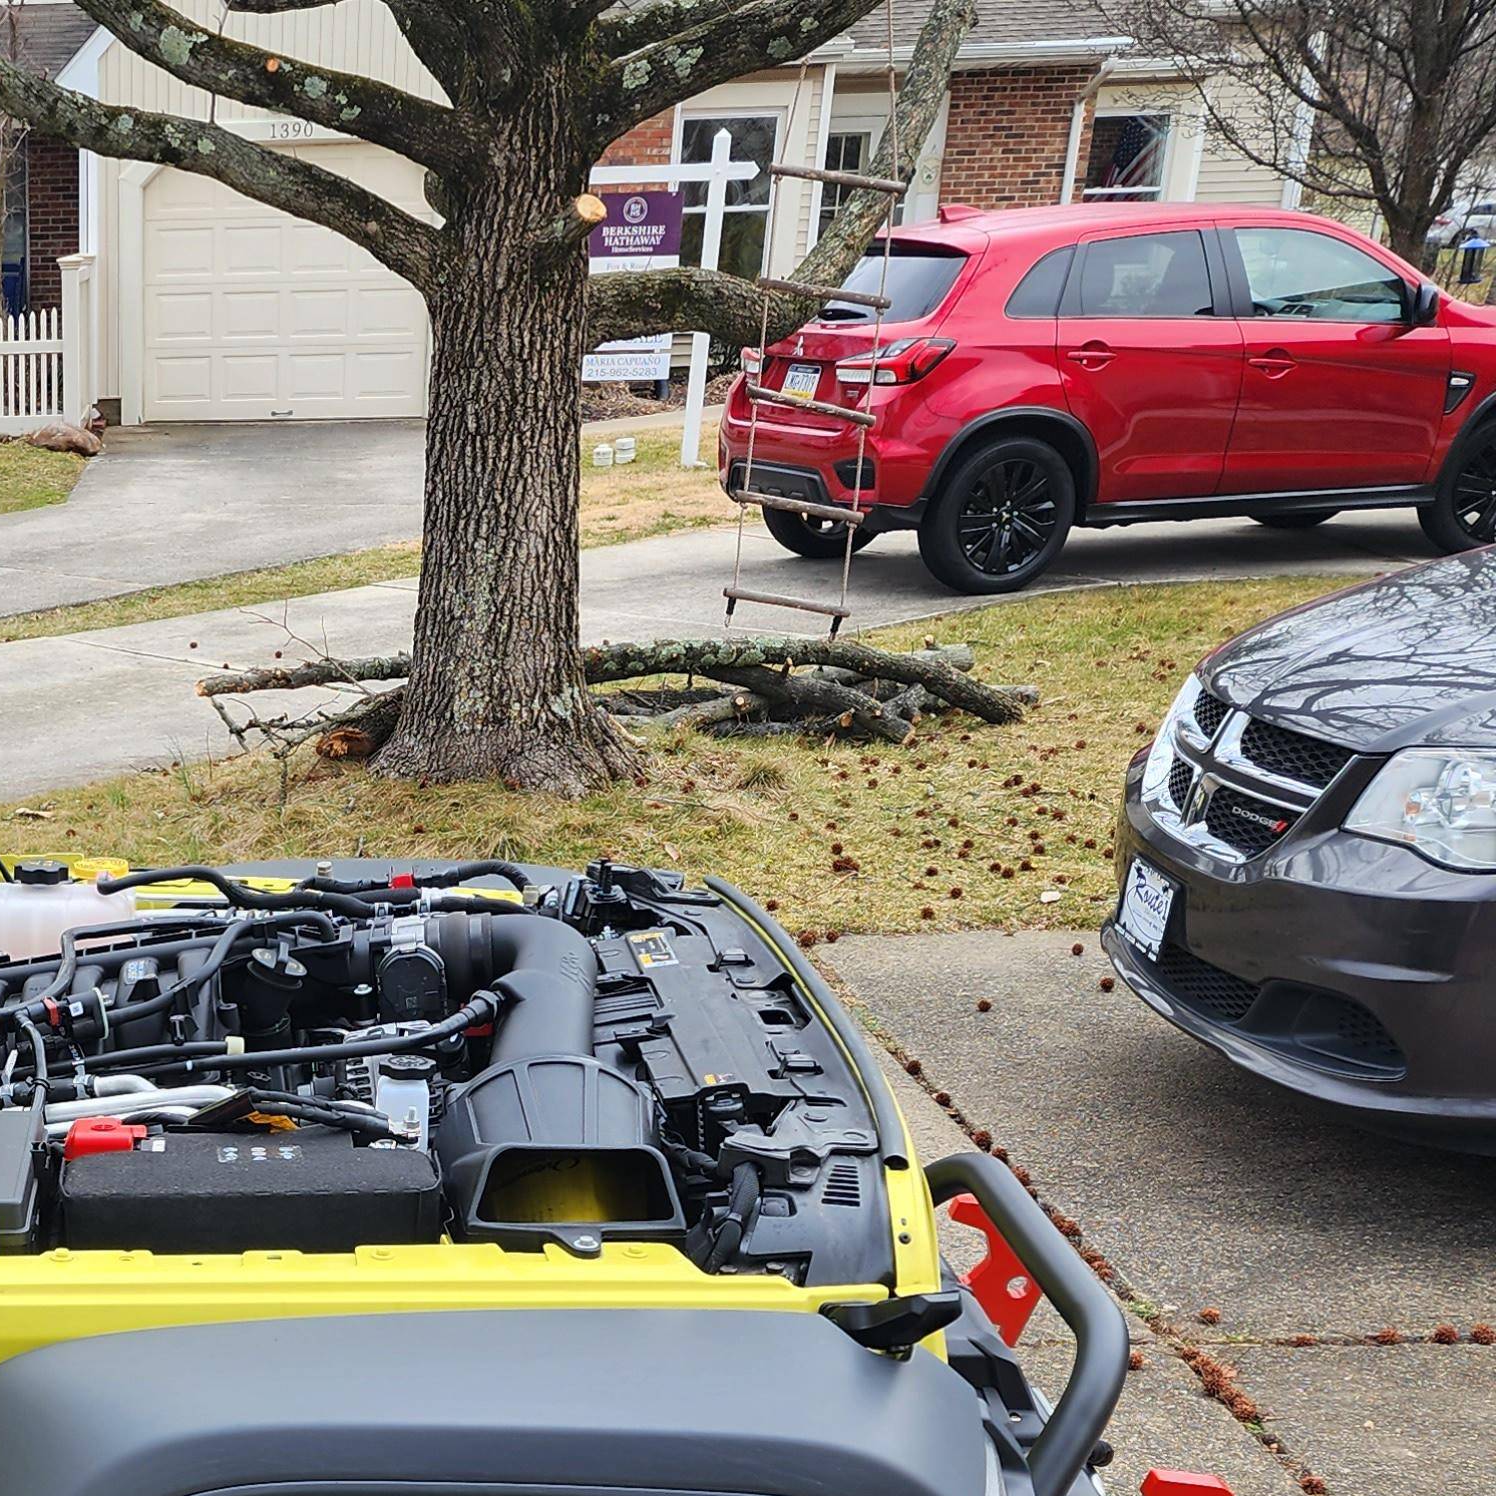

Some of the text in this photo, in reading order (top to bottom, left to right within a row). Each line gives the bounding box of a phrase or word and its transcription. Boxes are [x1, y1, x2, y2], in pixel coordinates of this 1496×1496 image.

[270, 121, 314, 139] 1390
[602, 225, 666, 236] BERKSHIRE
[604, 235, 664, 247] HATHAWAY
[1232, 806, 1278, 830] DODGE
